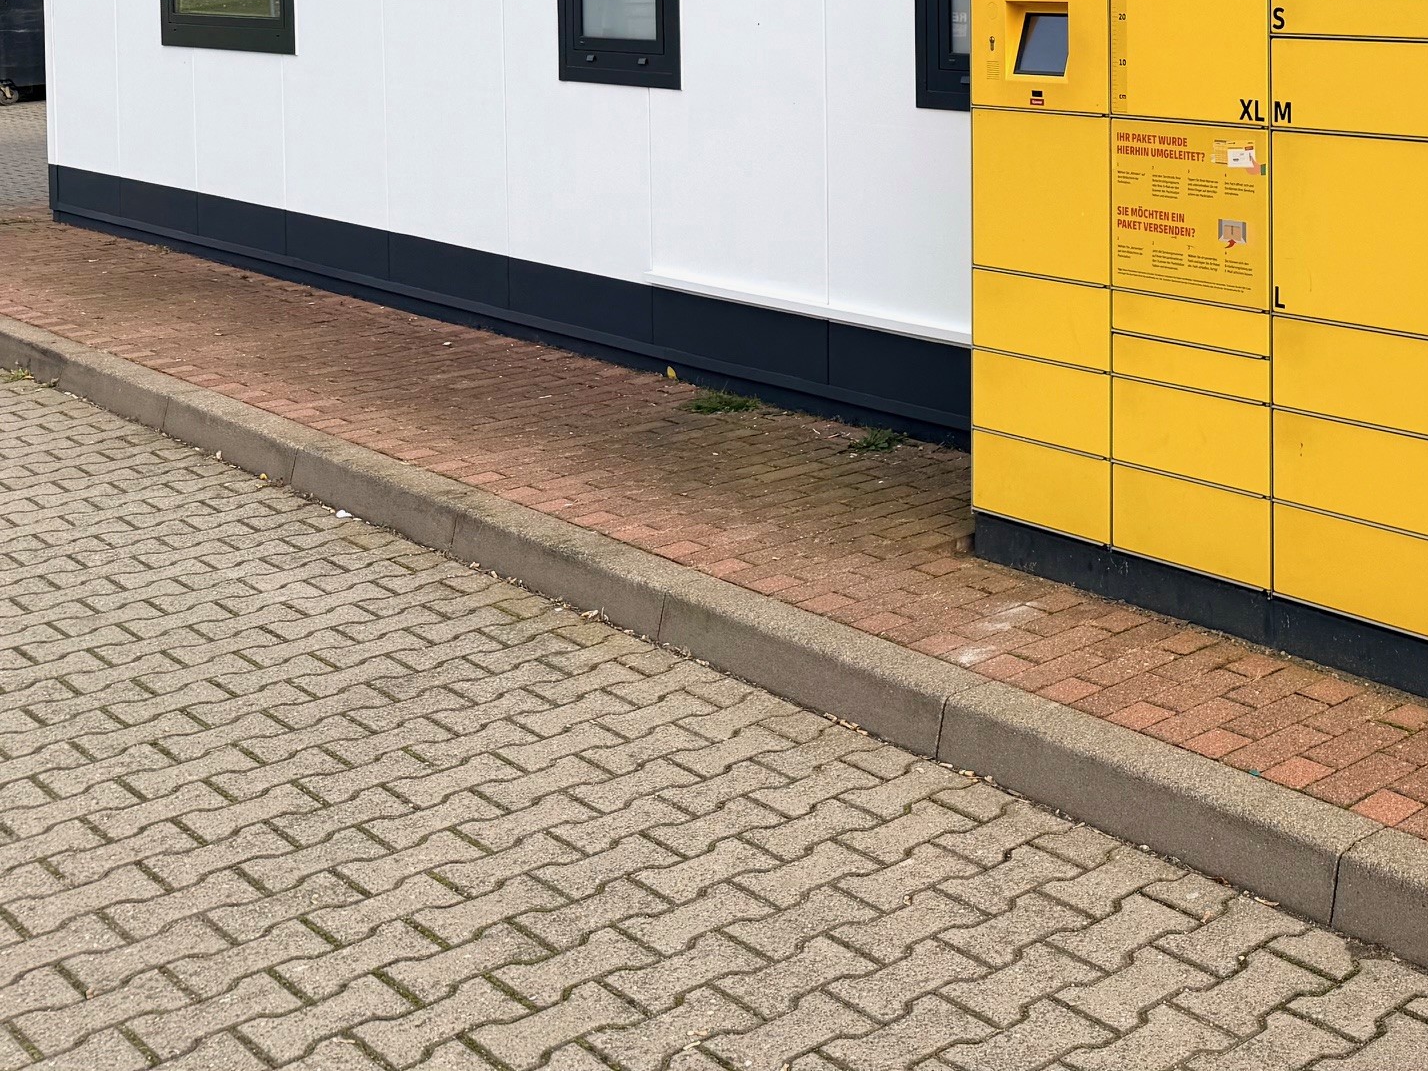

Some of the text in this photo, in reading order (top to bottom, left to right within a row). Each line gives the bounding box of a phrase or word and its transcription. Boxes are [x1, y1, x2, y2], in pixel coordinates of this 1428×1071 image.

[1118, 13, 1126, 21] 20
[1272, 7, 1285, 30] S
[1239, 99, 1265, 122] XL
[1274, 101, 1292, 123] M
[1117, 132, 1188, 147] IHR PAKET WURDE
[1117, 145, 1206, 162] HIERHIN UMGELEITET?
[1117, 206, 1185, 223] SIE MÖCHTEN EIN
[1117, 219, 1196, 238] PAKET VERSENDEN?
[1275, 285, 1286, 309] L
